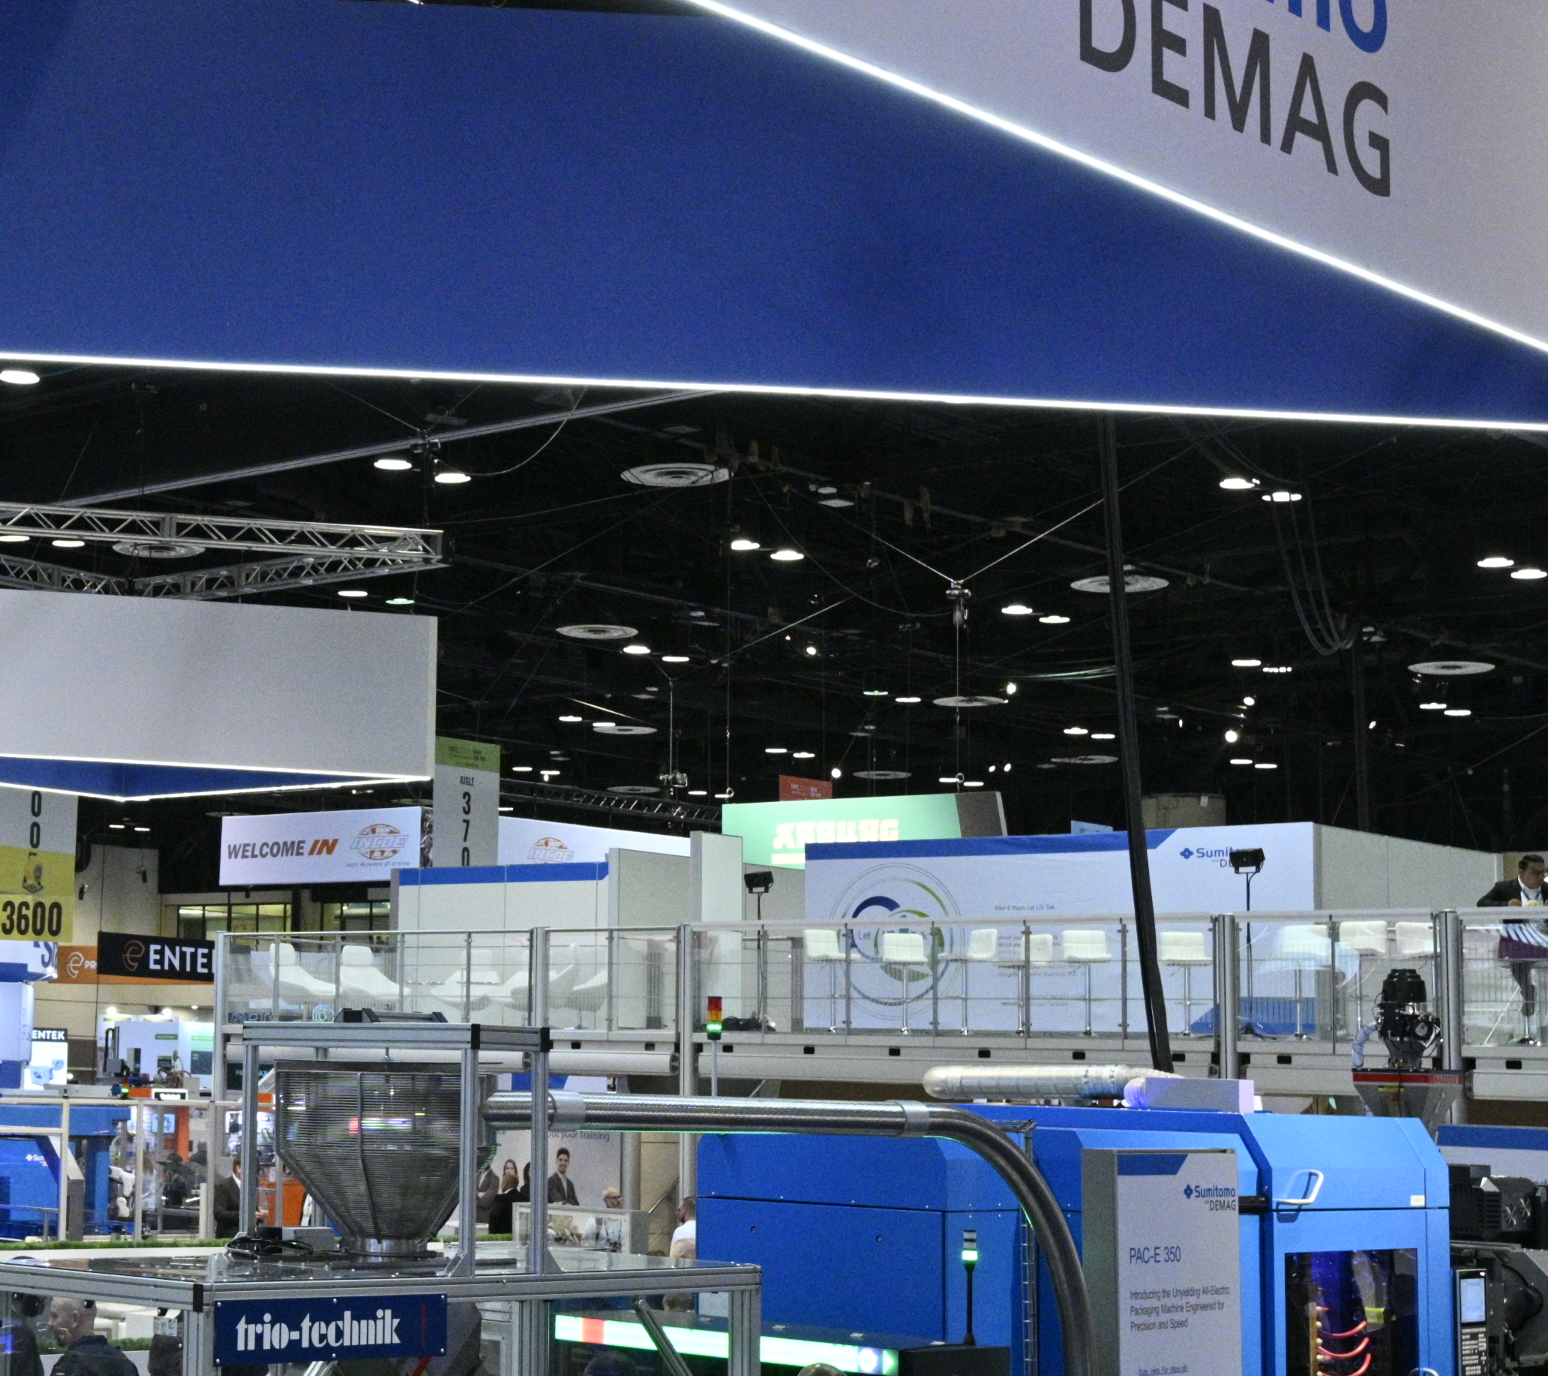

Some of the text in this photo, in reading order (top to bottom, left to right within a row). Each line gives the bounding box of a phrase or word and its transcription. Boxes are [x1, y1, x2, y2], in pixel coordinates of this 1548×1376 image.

[459, 776, 475, 787] AISLE
[351, 834, 408, 849] INCOE
[227, 838, 339, 860] WELCOME IN
[1, 901, 63, 936] 3600
[32, 1030, 65, 1041] ENTEK
[580, 1132, 610, 1142] Training
[1194, 1185, 1236, 1199] Sumitomo
[1209, 1199, 1236, 1212] DEMAG
[1129, 1246, 1181, 1264] PAC-E 350
[1130, 1290, 1161, 1302] Introducing
[1130, 1305, 1159, 1317] Packaging
[1161, 1303, 1184, 1314] Machine
[236, 1308, 402, 1351] trio-technik
[1131, 1321, 1156, 1333] Precision
[1170, 1318, 1188, 1330] Speed
